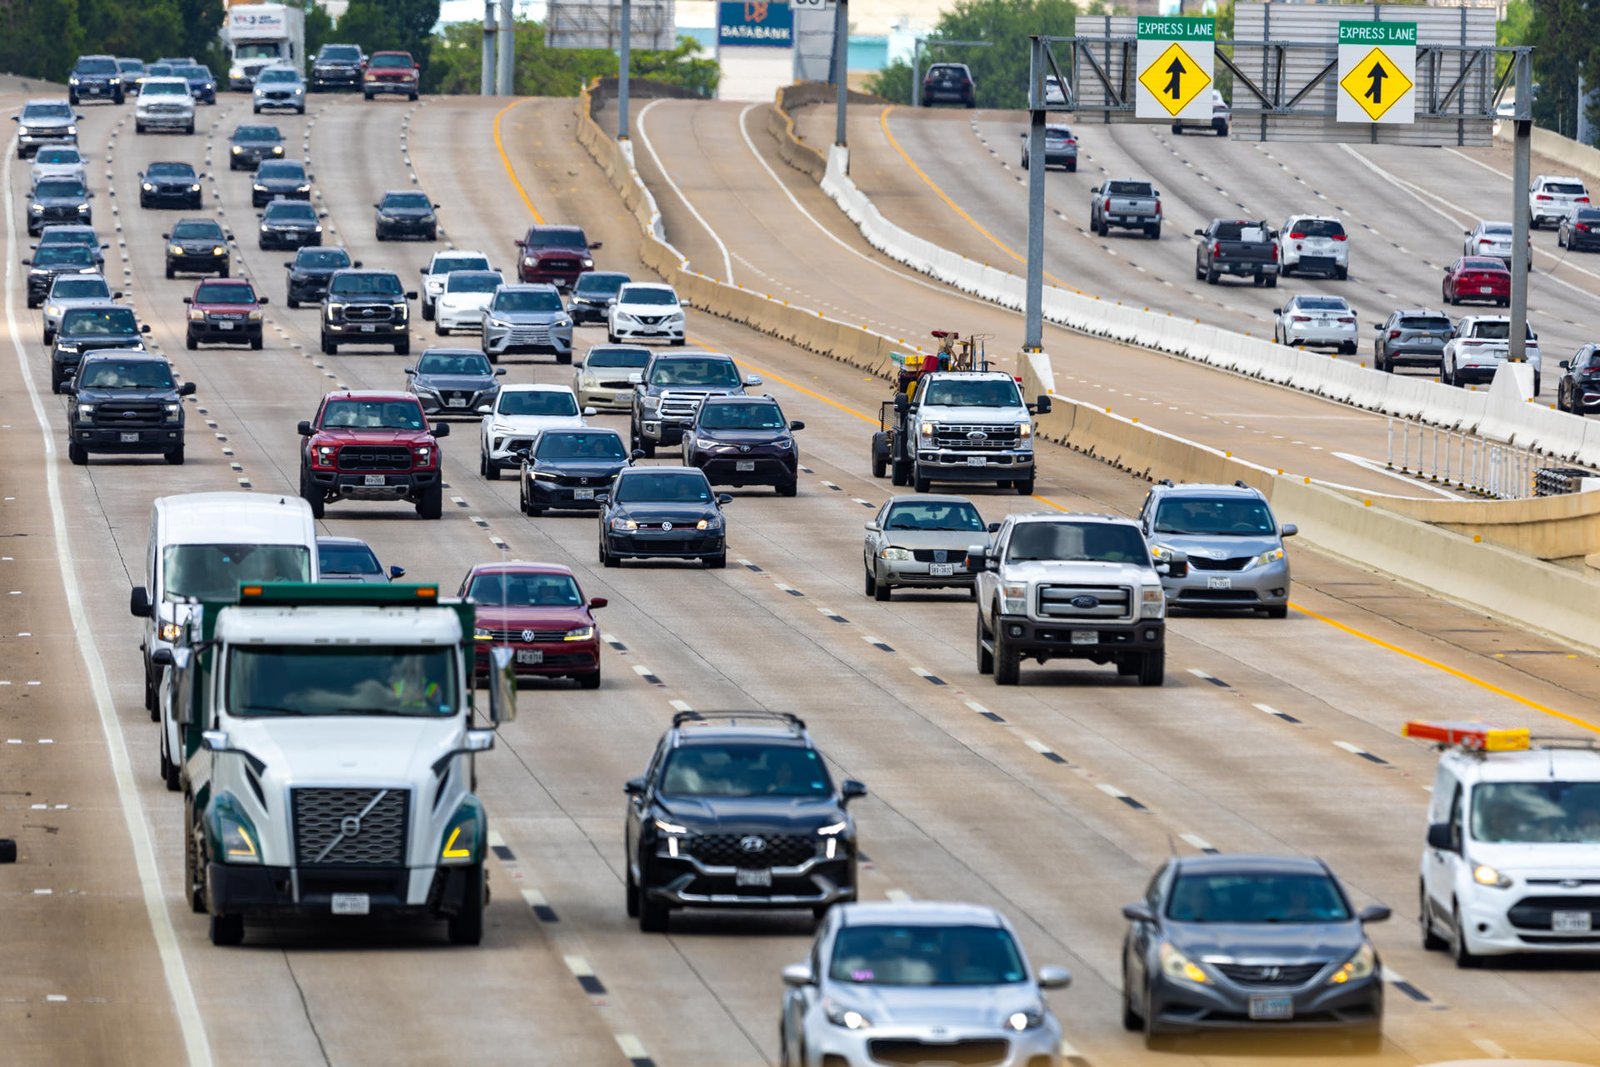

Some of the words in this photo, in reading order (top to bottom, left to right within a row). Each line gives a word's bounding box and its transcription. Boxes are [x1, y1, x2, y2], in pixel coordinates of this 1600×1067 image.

[720, 25, 790, 39] DATABANK
[1138, 22, 1184, 35] EXPRESS
[1186, 23, 1213, 36] LANE
[1340, 26, 1385, 40] EXPRESS
[1388, 28, 1416, 41] LANE
